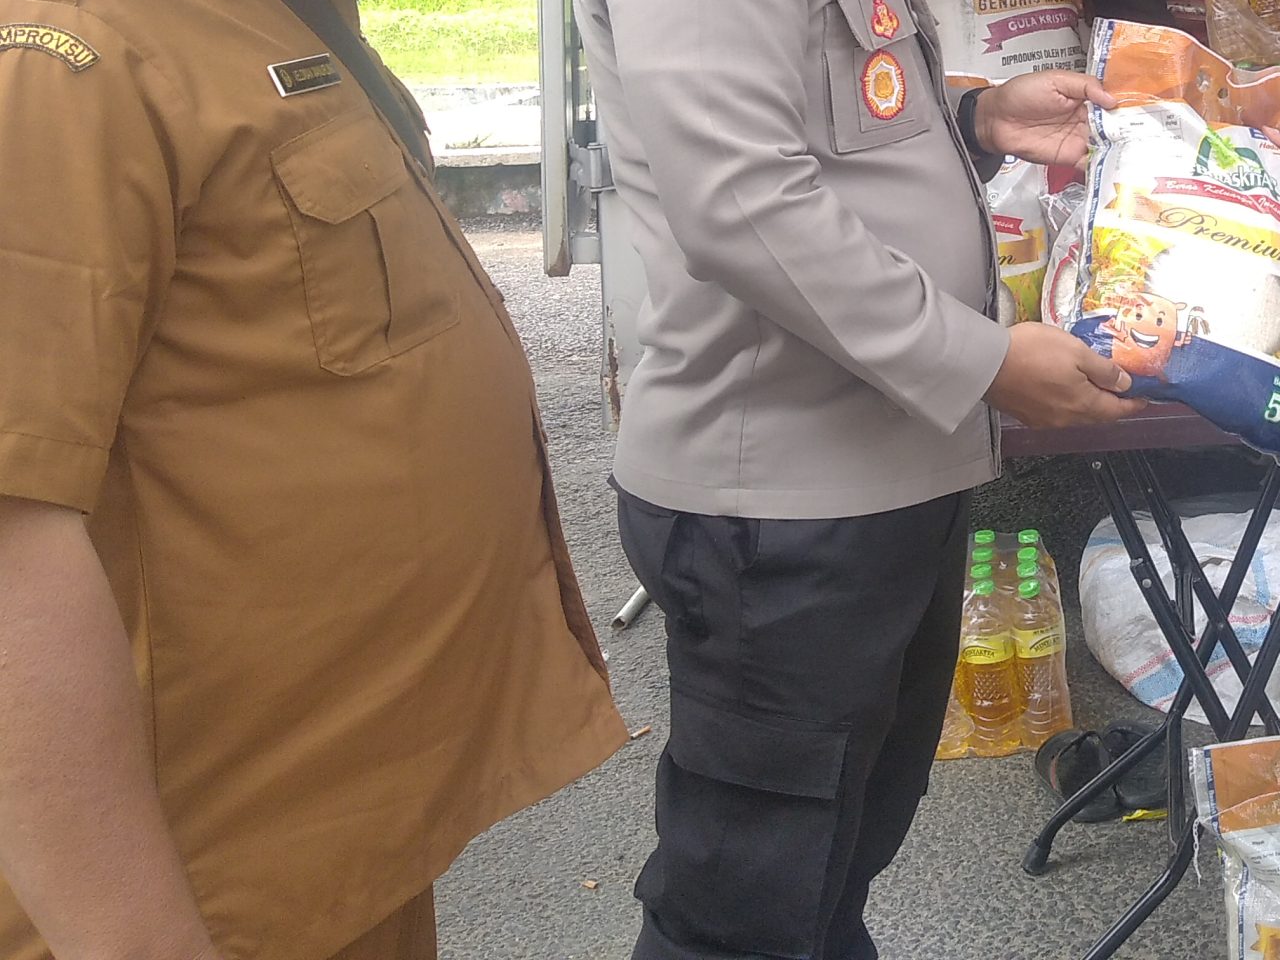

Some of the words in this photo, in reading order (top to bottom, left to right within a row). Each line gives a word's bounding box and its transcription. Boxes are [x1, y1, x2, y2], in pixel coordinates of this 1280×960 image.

[1008, 17, 1038, 31] GULA
[1002, 50, 1043, 67] DIPRODUKSI
[1044, 48, 1060, 59] OLEH
